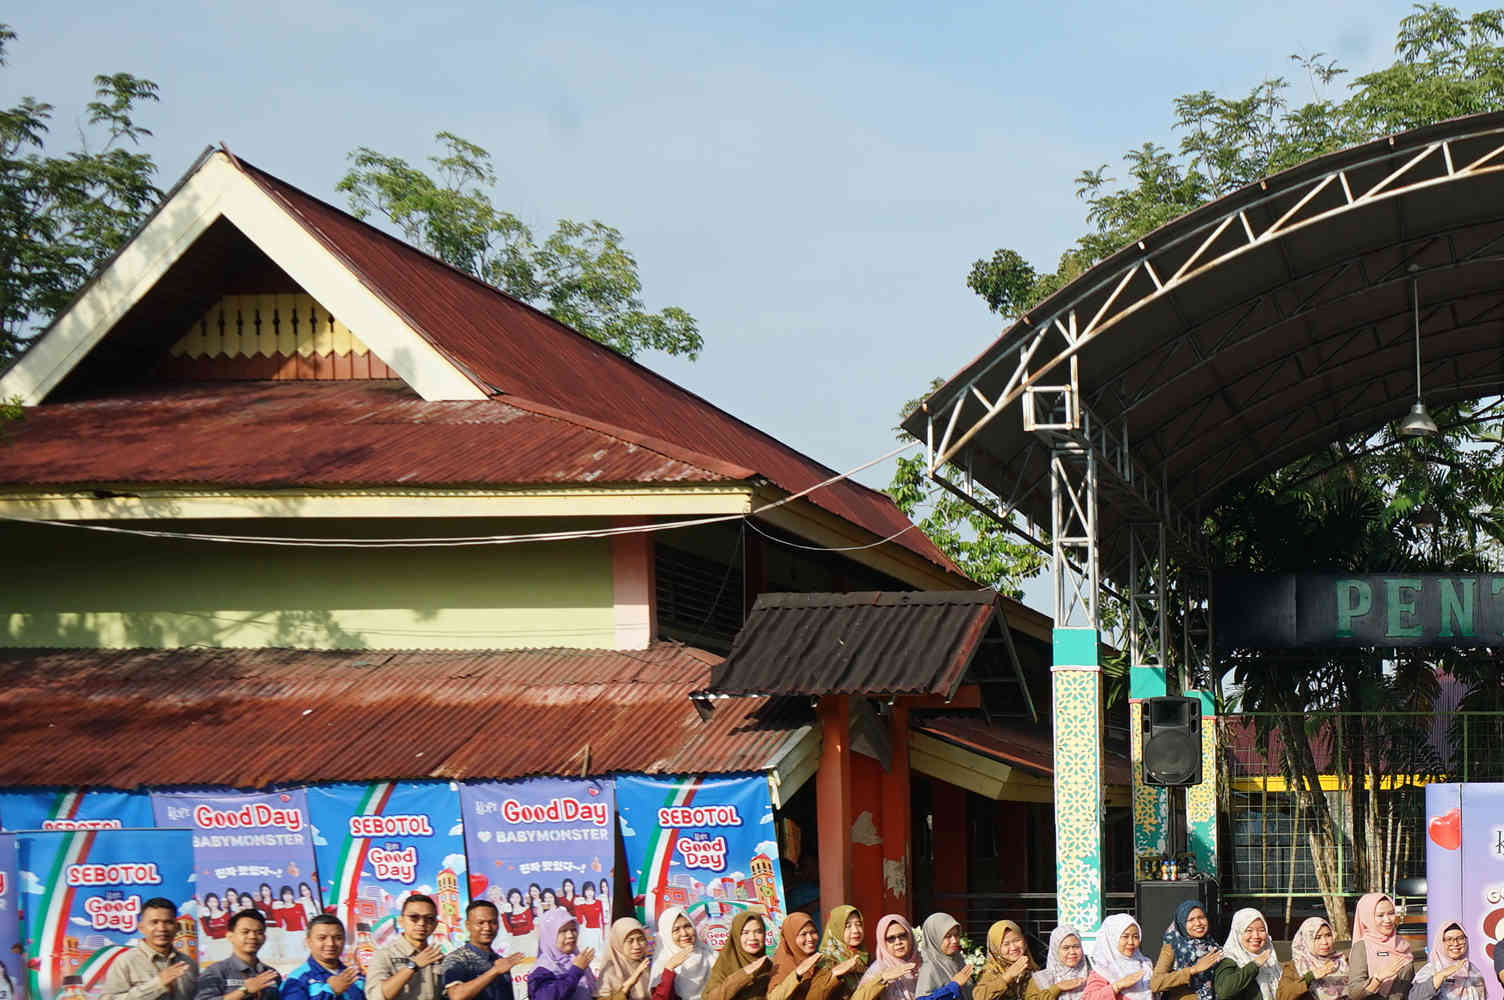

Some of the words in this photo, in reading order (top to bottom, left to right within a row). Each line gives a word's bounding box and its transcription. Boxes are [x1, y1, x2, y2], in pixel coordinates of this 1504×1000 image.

[196, 805, 252, 827] Good
[256, 804, 300, 830] Day
[503, 800, 559, 822] Good
[563, 799, 607, 825] Day
[660, 807, 739, 825] SEBOTOL
[351, 817, 430, 834] SEBOTOL
[496, 829, 609, 843] BABYMONSTER
[679, 838, 724, 853] Good
[370, 848, 414, 864] Good
[686, 853, 722, 869] Day
[69, 866, 158, 883] SEBOTOL
[377, 864, 412, 880] Day
[87, 898, 137, 913] Good
[94, 914, 135, 929] Day
